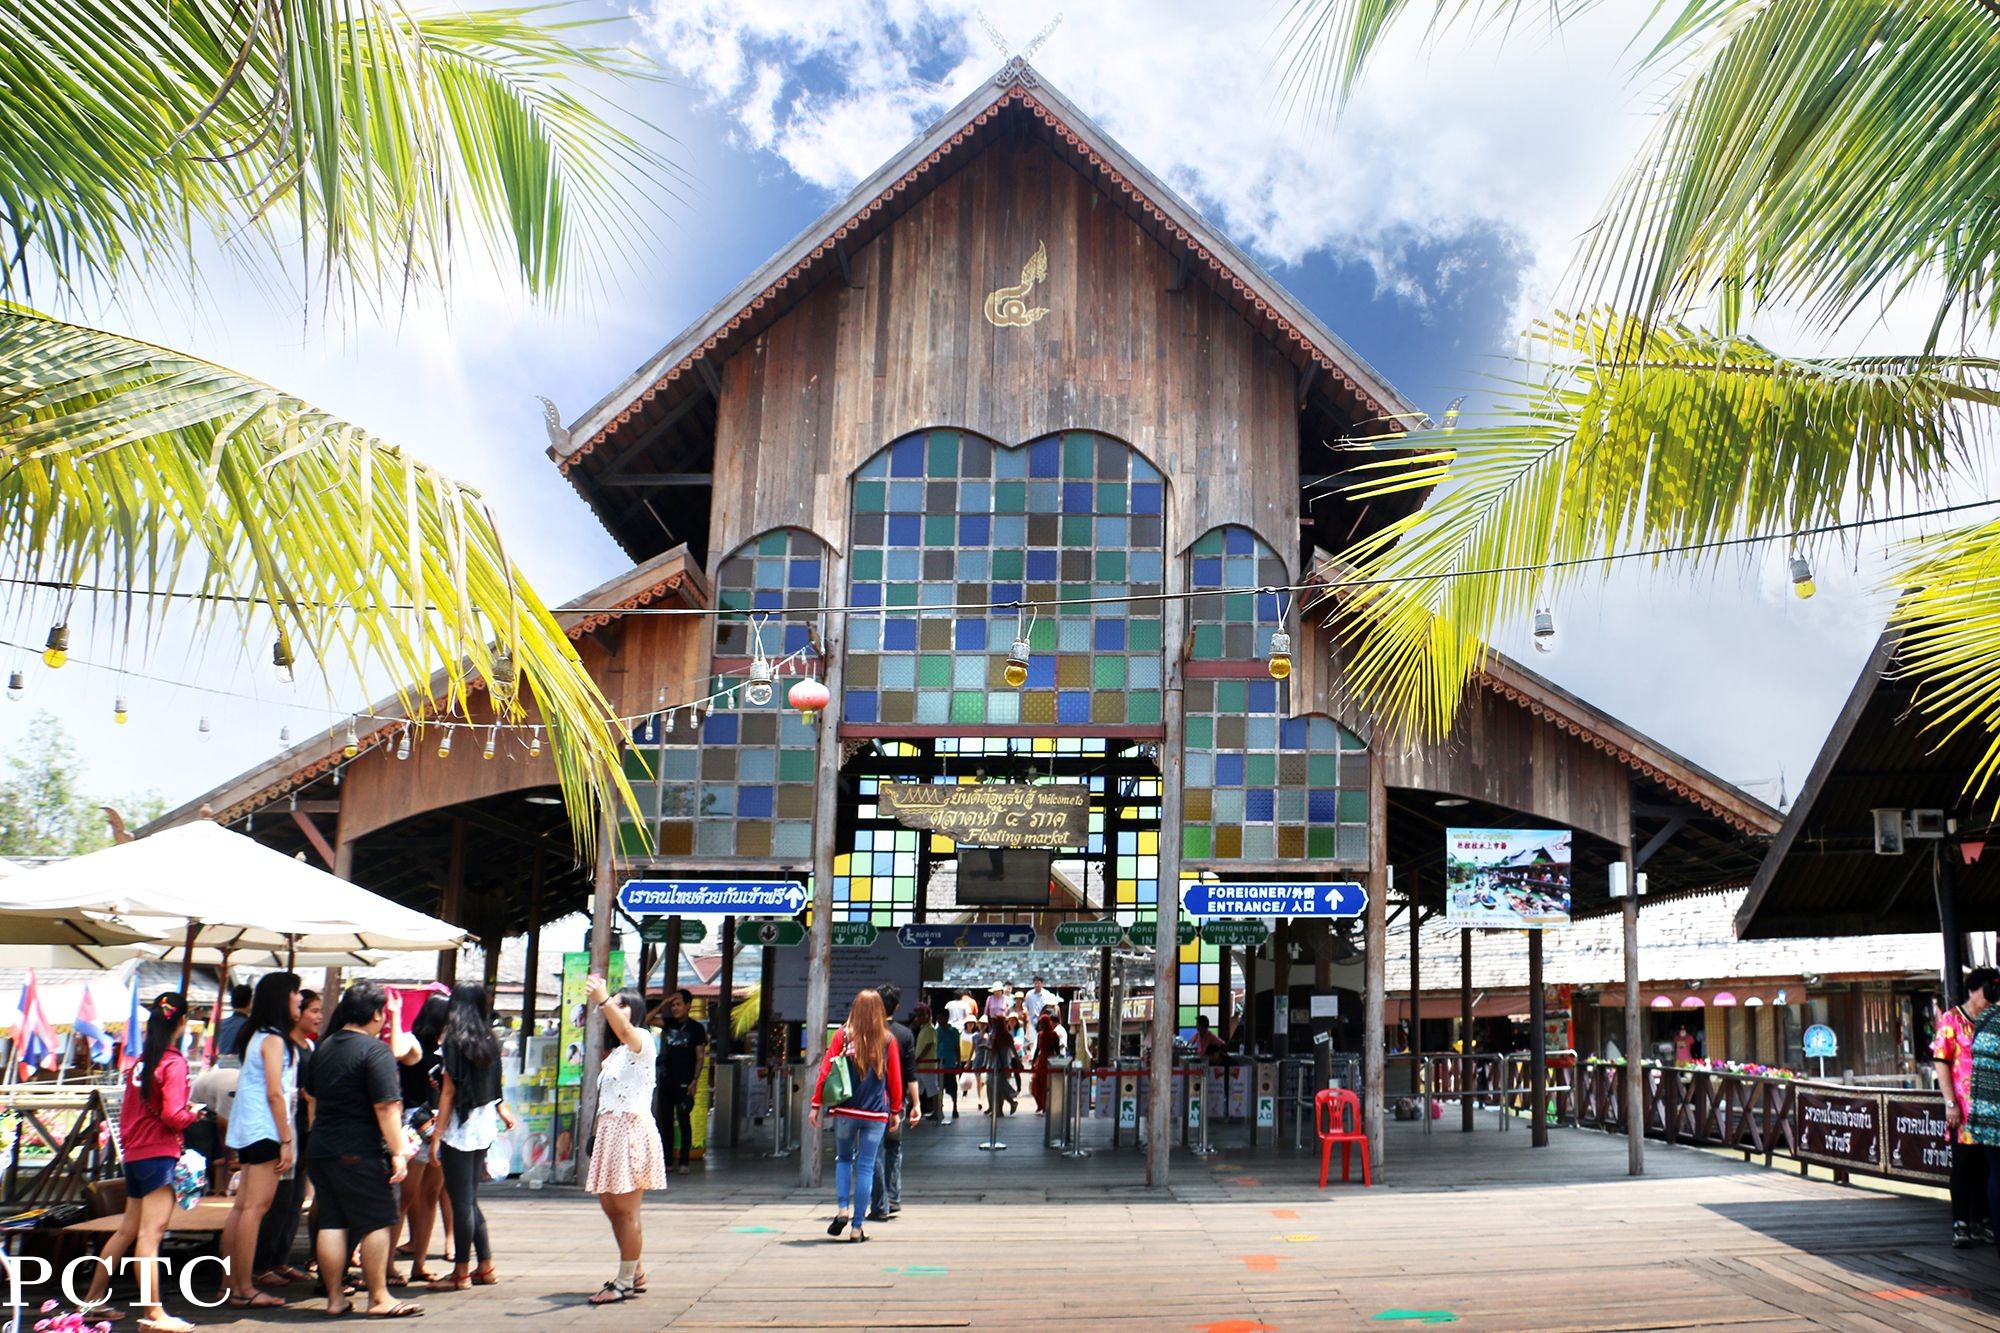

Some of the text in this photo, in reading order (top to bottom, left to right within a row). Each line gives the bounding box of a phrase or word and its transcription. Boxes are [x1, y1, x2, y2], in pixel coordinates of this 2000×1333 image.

[1037, 793, 1075, 806] Welcome
[930, 804, 1006, 830] ตลาดน้ำ
[1029, 811, 1068, 829] ภาค
[963, 828, 1071, 846] Floating market
[628, 884, 787, 906] เราคนไทยด้วยกันเข้าฟรี
[1207, 901, 1286, 913] ENTRANCE/
[1073, 936, 1086, 945] IN
[1141, 936, 1153, 945] IN
[1214, 936, 1226, 945] IN
[1896, 1110, 1947, 1138] เราคนไทย
